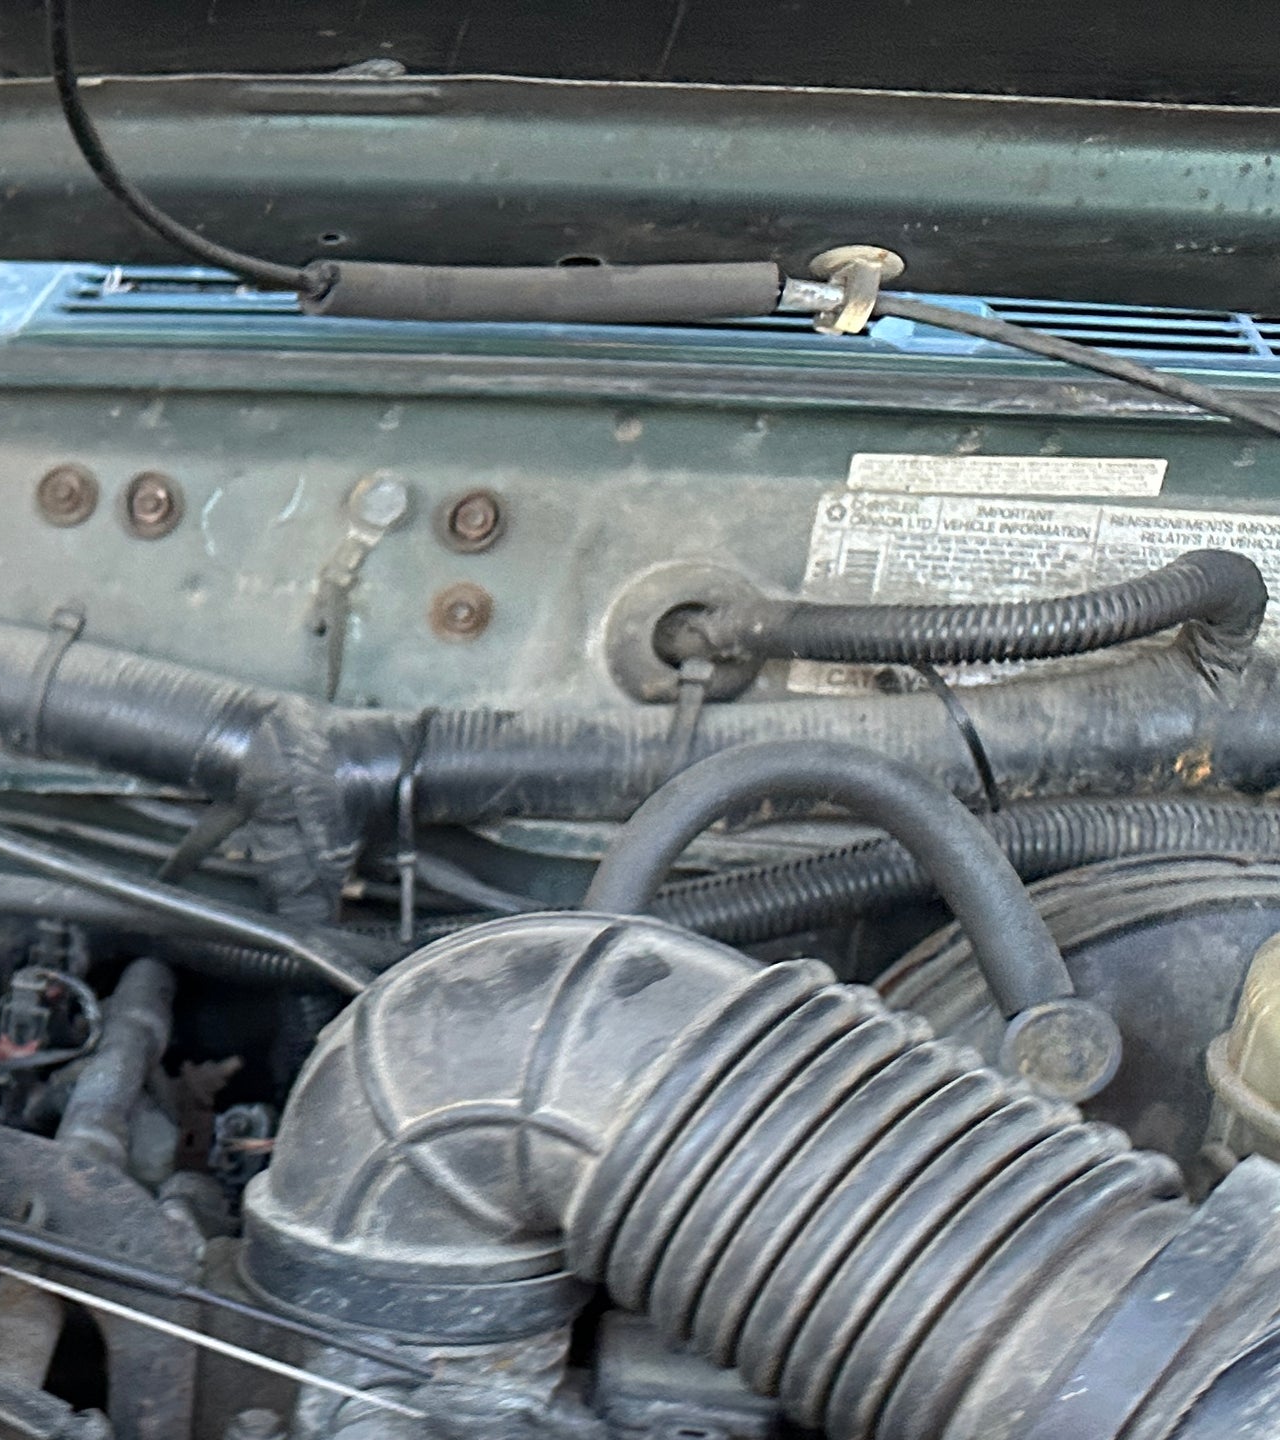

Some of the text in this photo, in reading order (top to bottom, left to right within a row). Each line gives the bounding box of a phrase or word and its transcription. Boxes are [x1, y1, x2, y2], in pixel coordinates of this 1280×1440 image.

[976, 505, 1055, 521] IMPORTANT
[943, 518, 1092, 539] VEHICLE INFORMATION
